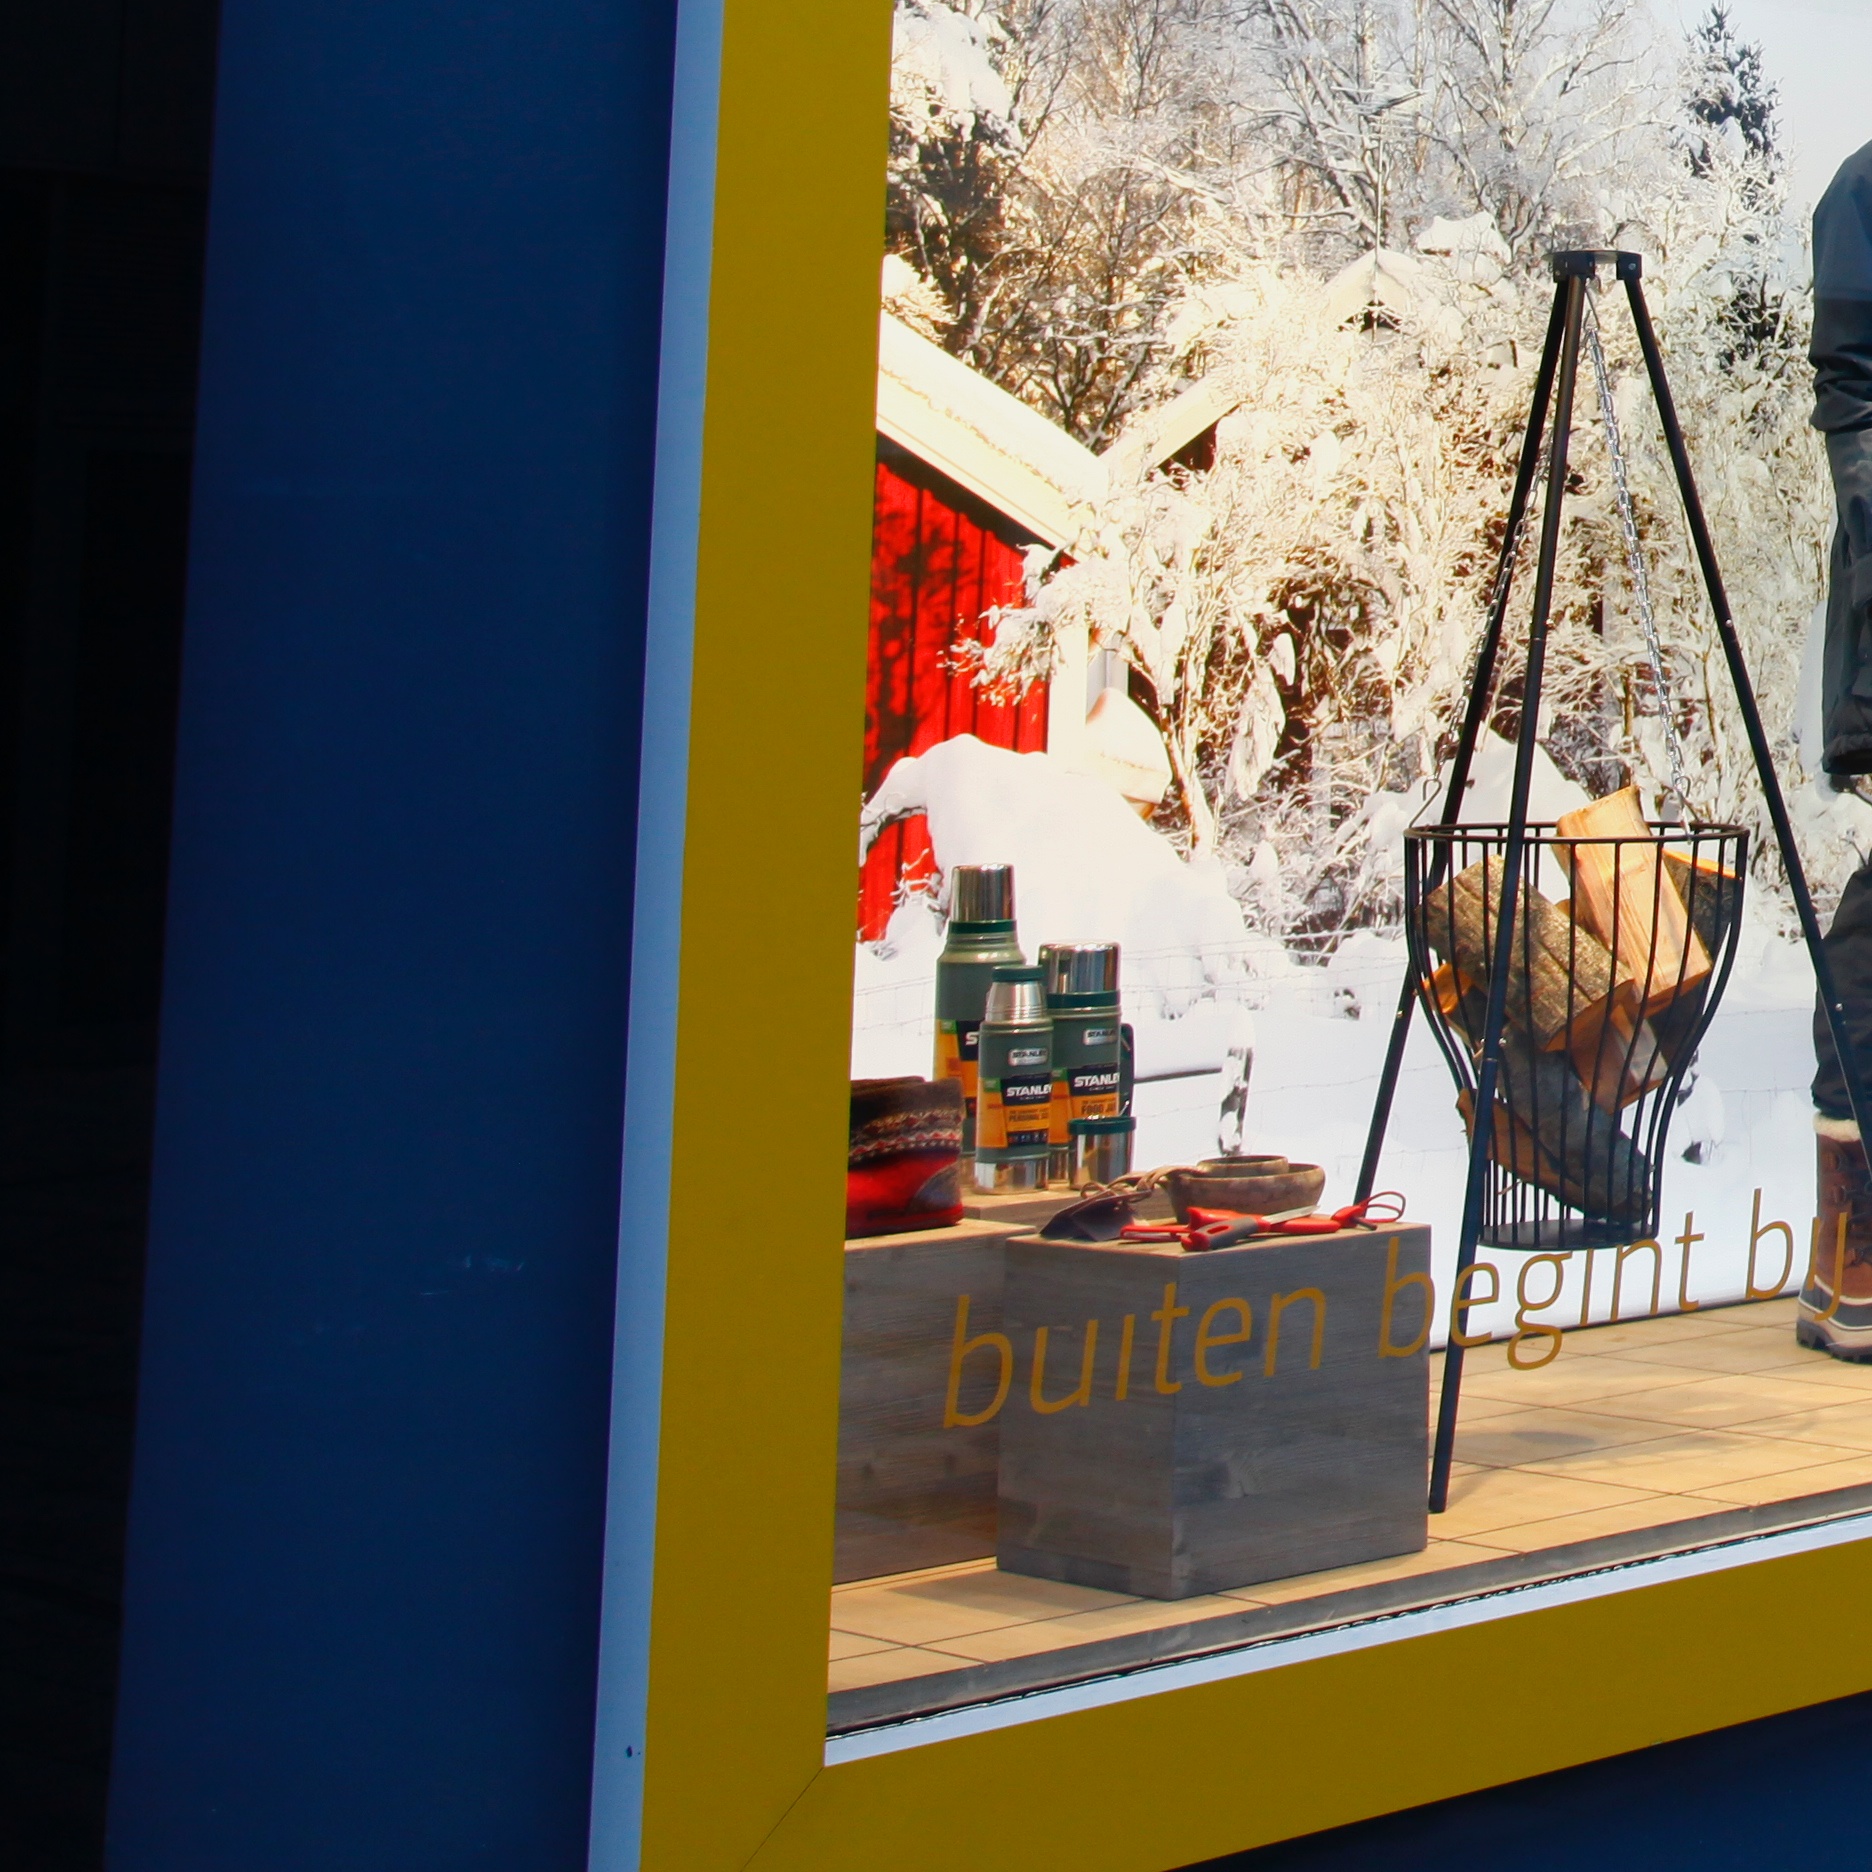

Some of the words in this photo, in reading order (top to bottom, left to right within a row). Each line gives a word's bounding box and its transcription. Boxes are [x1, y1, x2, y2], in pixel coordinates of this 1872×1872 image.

[942, 1281, 1328, 1429] buiten
[1376, 1210, 1705, 1371] begint
[1744, 1186, 1849, 1322] bij
